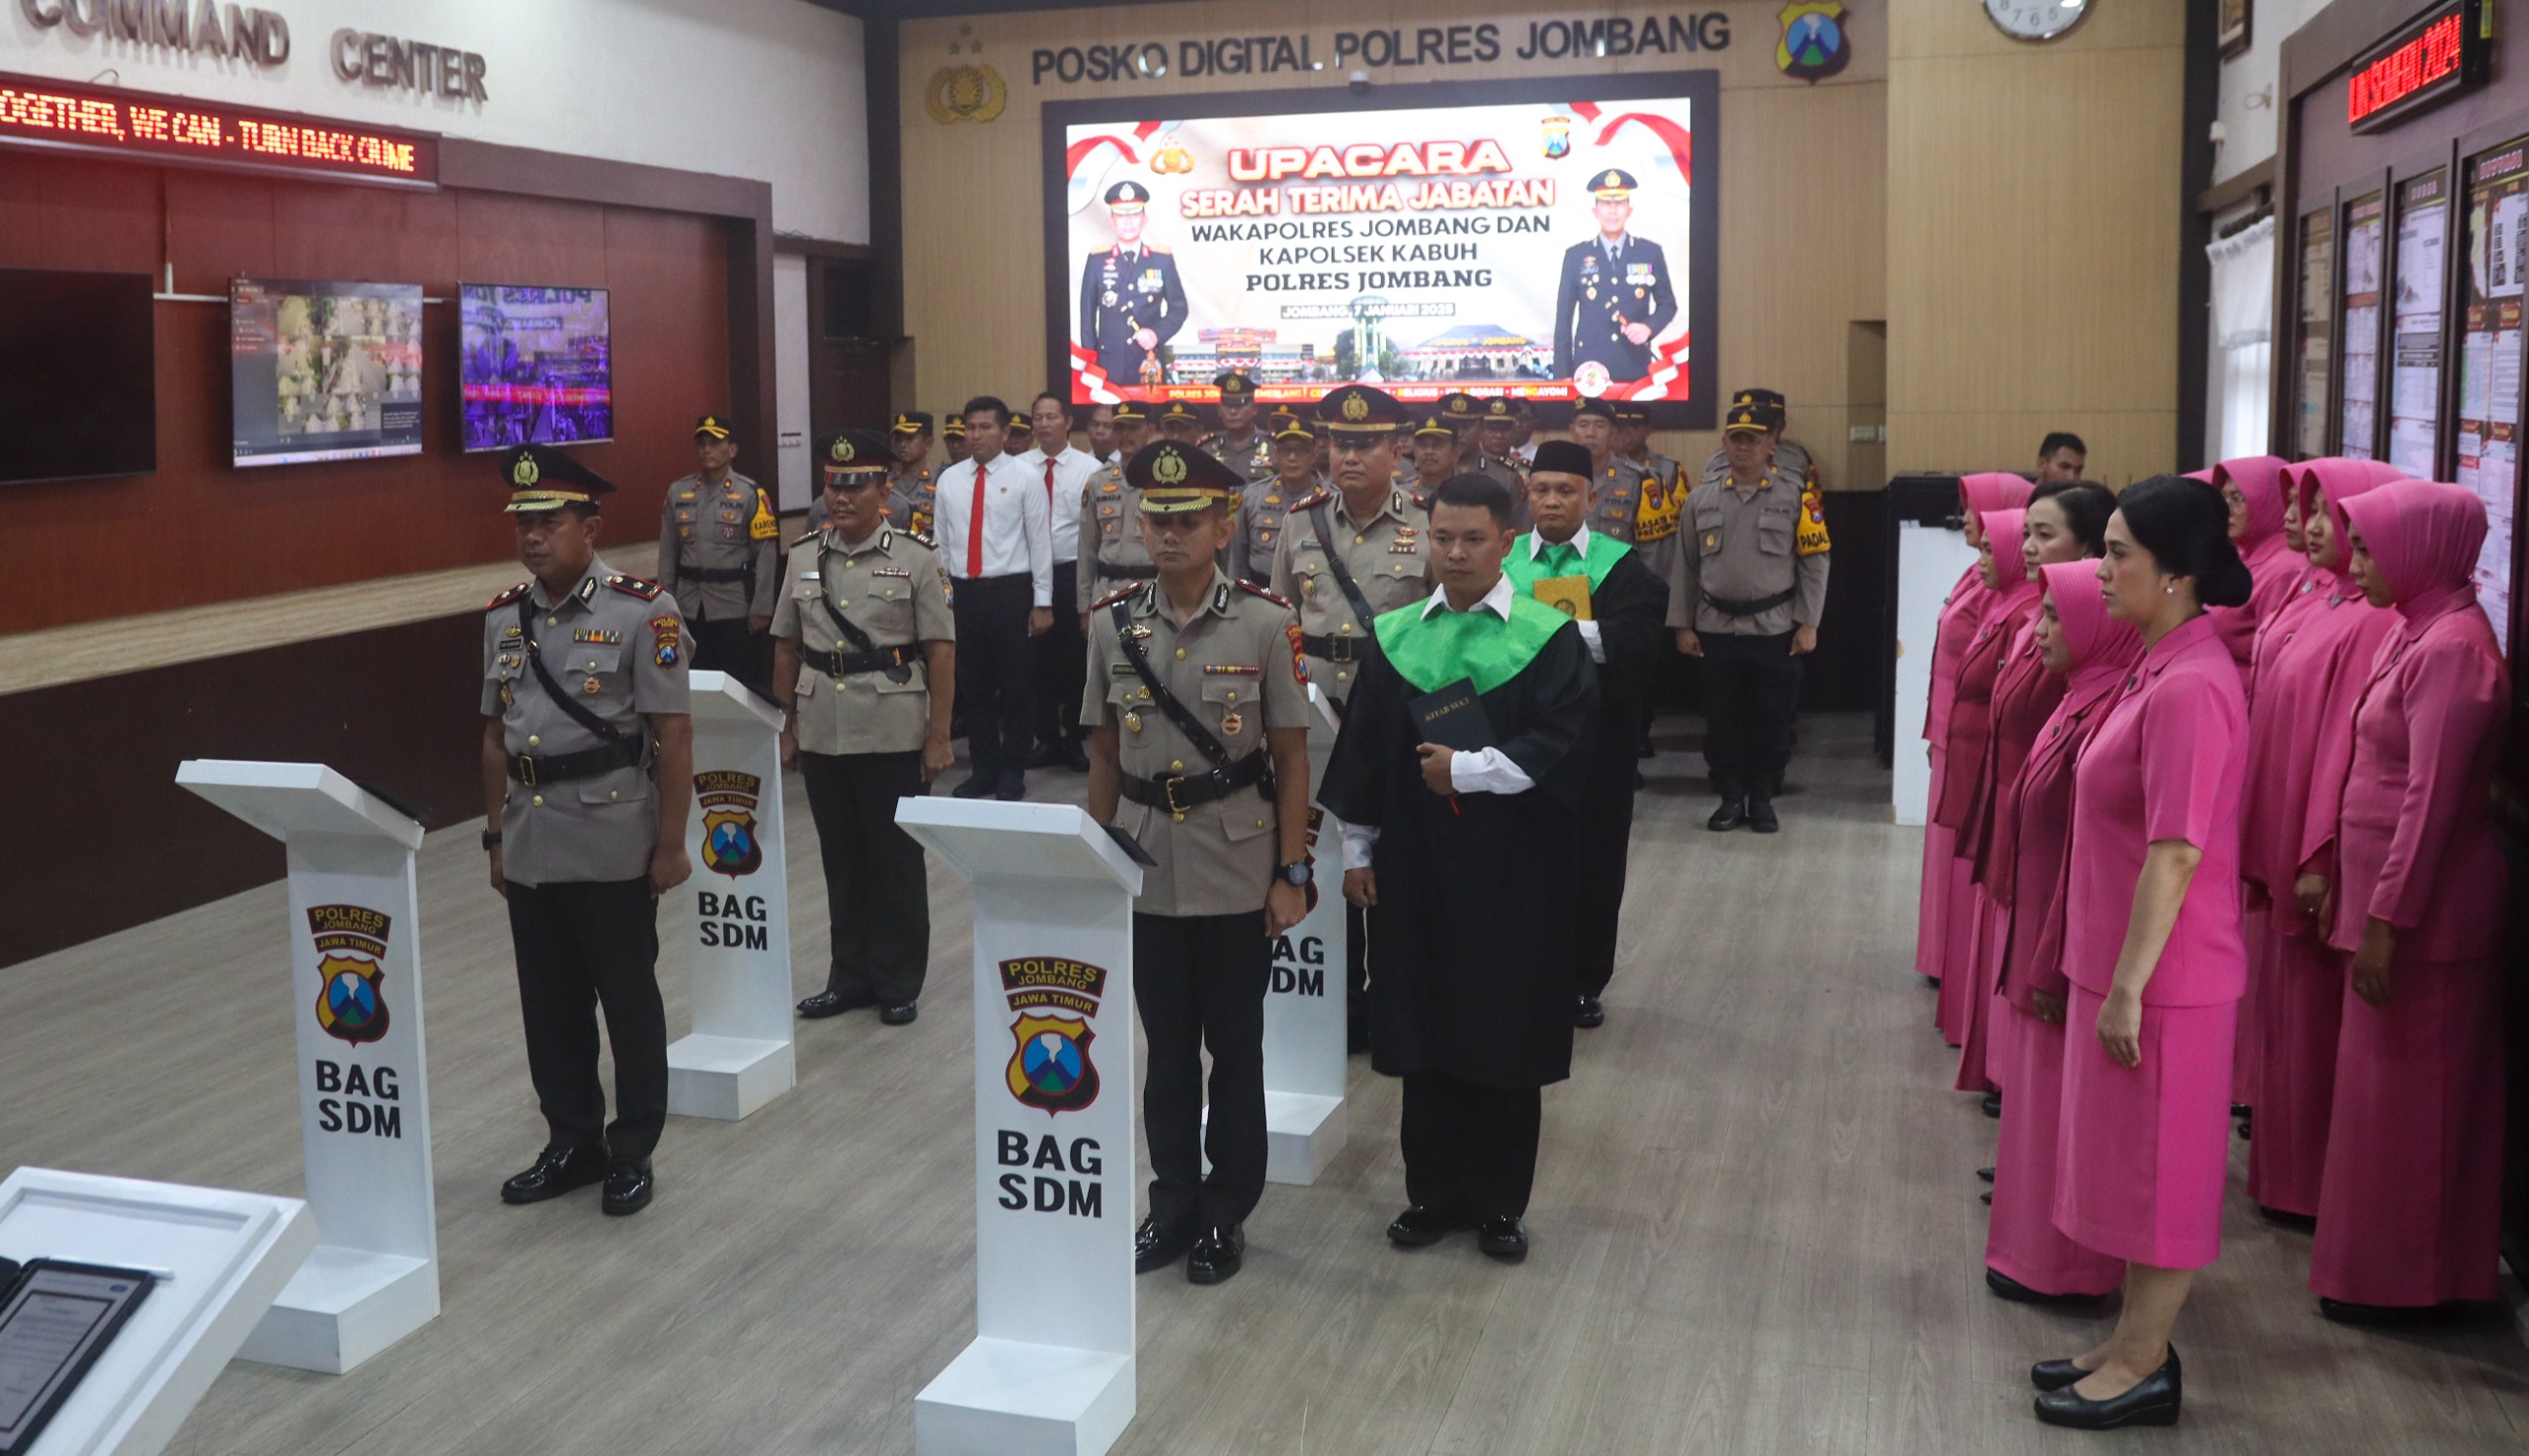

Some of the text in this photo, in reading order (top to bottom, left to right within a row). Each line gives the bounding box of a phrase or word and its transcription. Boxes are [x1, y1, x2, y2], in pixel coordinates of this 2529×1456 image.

[2013, 9, 2022, 21] 7
[2030, 12, 2040, 27] 6
[22, 0, 489, 102] COMMAND CENTER
[1032, 12, 1731, 85] POSKO DIGITAL POLRES JOMBANG
[2423, 14, 2461, 86] 2024
[0, 90, 125, 141] OGETHER,
[129, 106, 168, 141] WE
[172, 112, 220, 146] CAN
[238, 120, 298, 155] TURN
[301, 129, 354, 162] BACK
[357, 136, 414, 172] CRIME
[1228, 138, 1512, 182] UPACARA
[1181, 178, 1555, 218] SERAH TERIMA JABATAN
[1191, 214, 1550, 243] WAKAPOLRES JOMBANG DAN
[1260, 243, 1478, 266] KAPOLSEK KABUH
[1246, 269, 1492, 293] POLRES JOMBANG
[1364, 303, 1420, 316] JANUARI
[1255, 388, 1301, 398] EMERLANG
[697, 772, 756, 788] POLRES
[702, 795, 754, 807] JAWA TIMUR
[314, 908, 384, 929] POLRES
[697, 891, 767, 922] BAG
[322, 920, 376, 935] JOMBANG
[699, 921, 768, 951] SDM
[319, 936, 382, 954] JAWA TIMUR
[1271, 934, 1325, 965] AG
[1009, 960, 1098, 983] POLRES
[1019, 974, 1088, 990] JOMBANG
[1271, 966, 1325, 998] DM
[1013, 994, 1093, 1012] JAWA TIMUR
[315, 1059, 399, 1100] BAG
[319, 1098, 401, 1139] SDM
[998, 1129, 1101, 1175] BAG
[998, 1173, 1102, 1218] SDM
